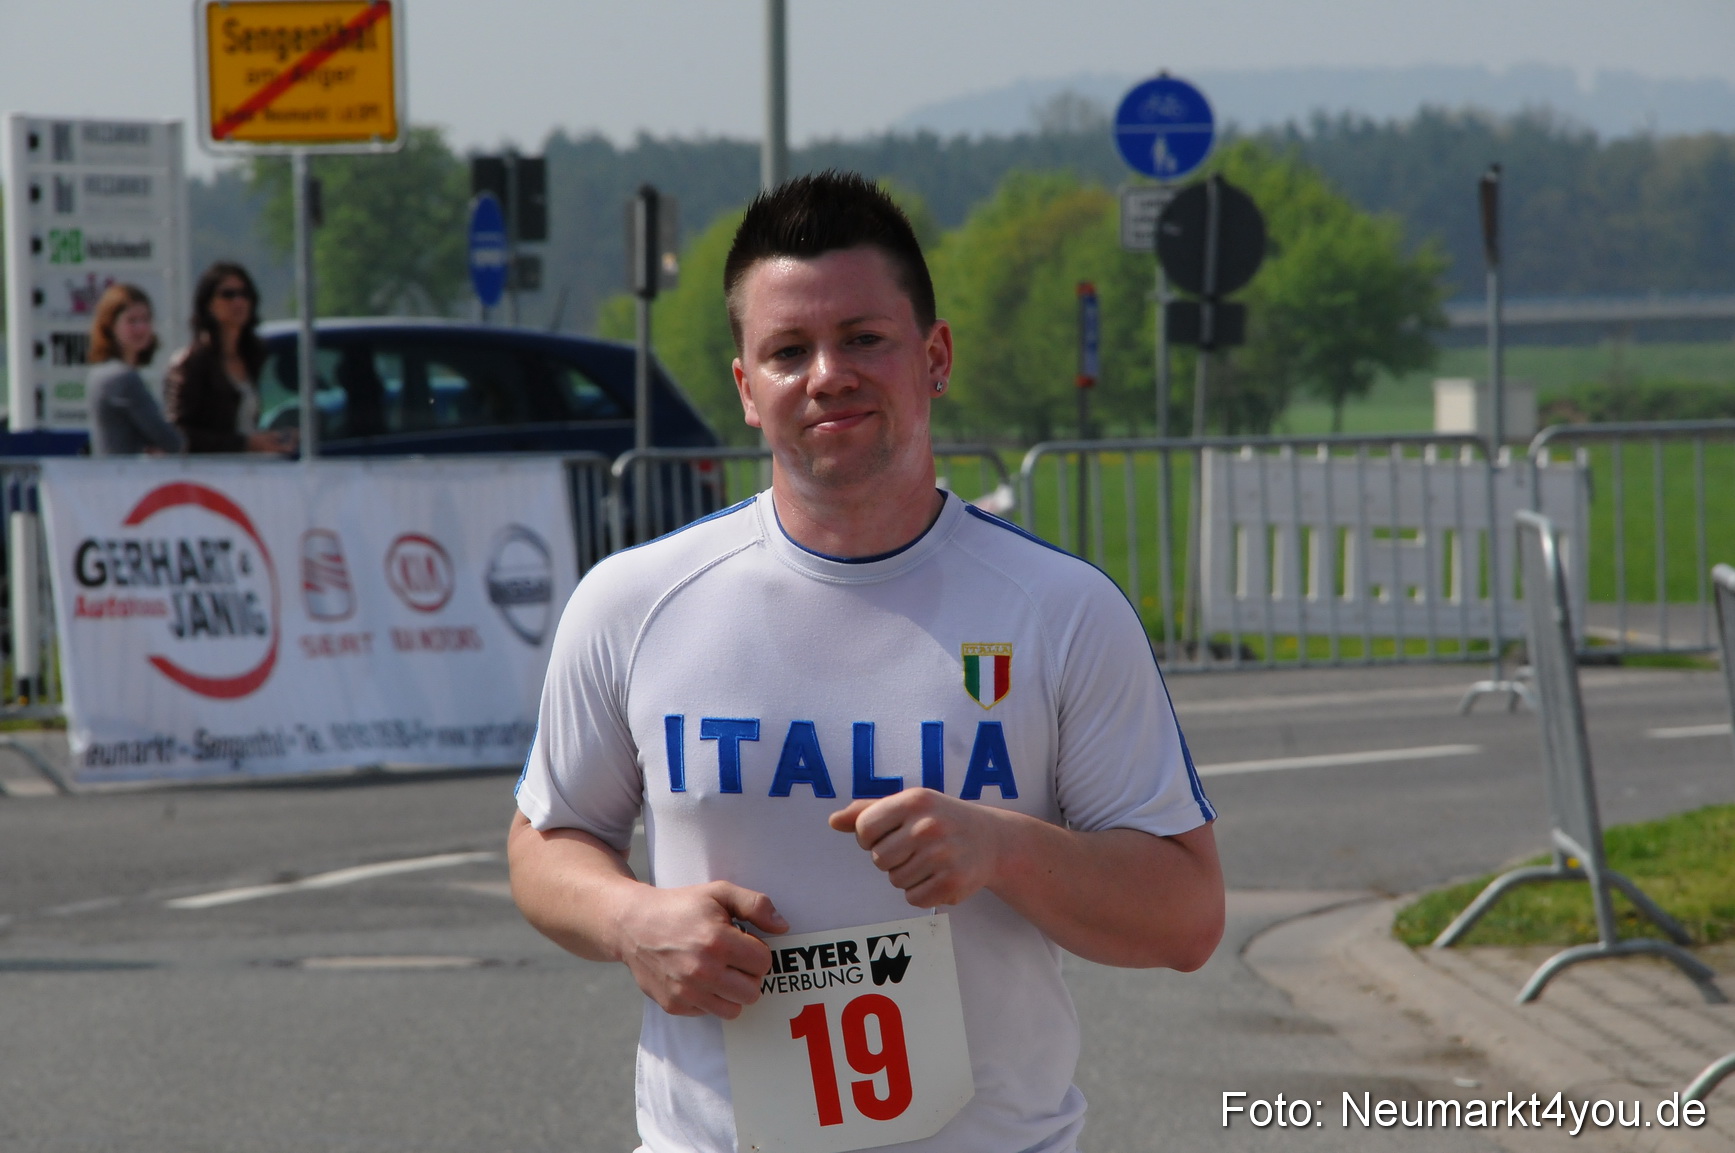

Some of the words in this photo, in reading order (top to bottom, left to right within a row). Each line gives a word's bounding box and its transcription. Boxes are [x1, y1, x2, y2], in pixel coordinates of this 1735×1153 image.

[74, 538, 235, 587] GERHART
[664, 713, 1019, 801] ITALIA
[760, 966, 864, 996] WERBUNG
[789, 993, 913, 1127] 19
